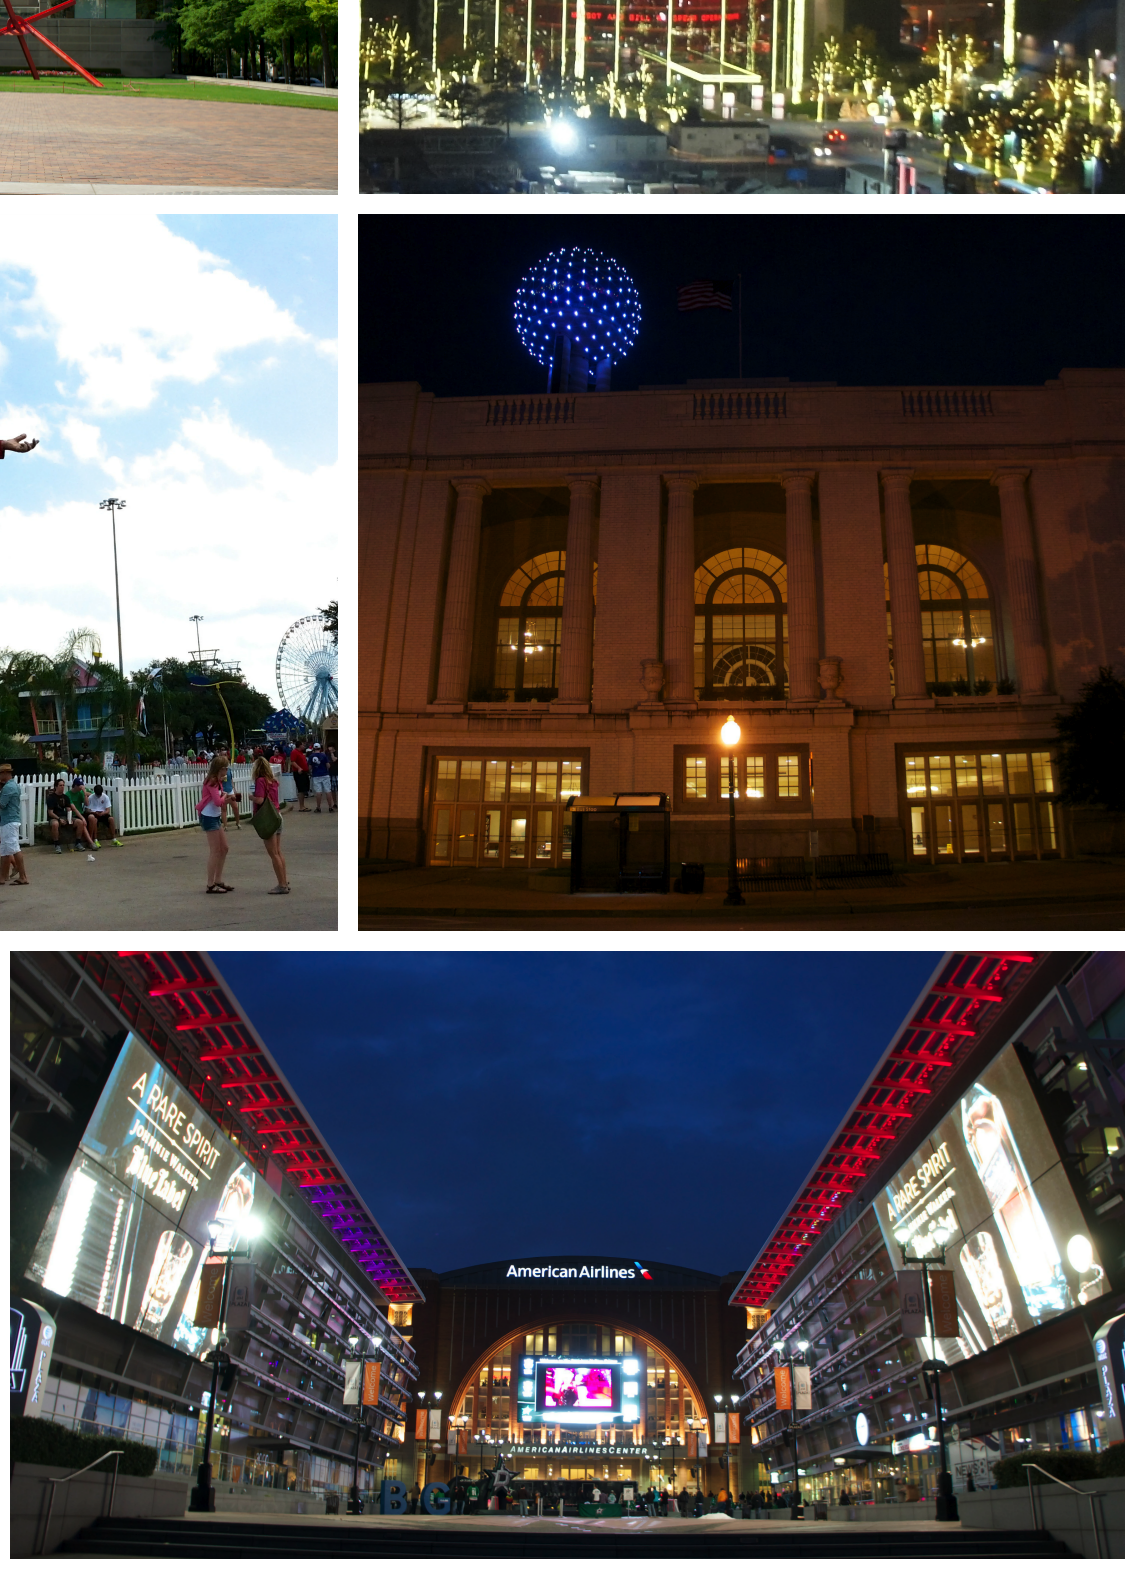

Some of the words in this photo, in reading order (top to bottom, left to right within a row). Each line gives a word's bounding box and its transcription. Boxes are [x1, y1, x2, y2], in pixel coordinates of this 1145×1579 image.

[129, 1119, 171, 1163] JOHNNIE
[132, 1072, 147, 1098] A
[146, 1084, 187, 1136] RARE
[182, 1123, 221, 1170] SPIRIT
[125, 1145, 159, 1190] Blue
[152, 1168, 187, 1212] Label
[887, 1202, 897, 1222] A
[893, 1175, 921, 1214] RARE
[917, 1141, 951, 1189] SPIRIT
[201, 1267, 219, 1323] Welcome
[506, 1264, 578, 1279] American
[578, 1265, 636, 1279] Airlines
[939, 1274, 953, 1333] Welcome
[367, 1365, 377, 1402] Welcome
[955, 1462, 979, 1477] NEWS
[380, 1480, 407, 1515] B
[421, 1482, 451, 1515] G
